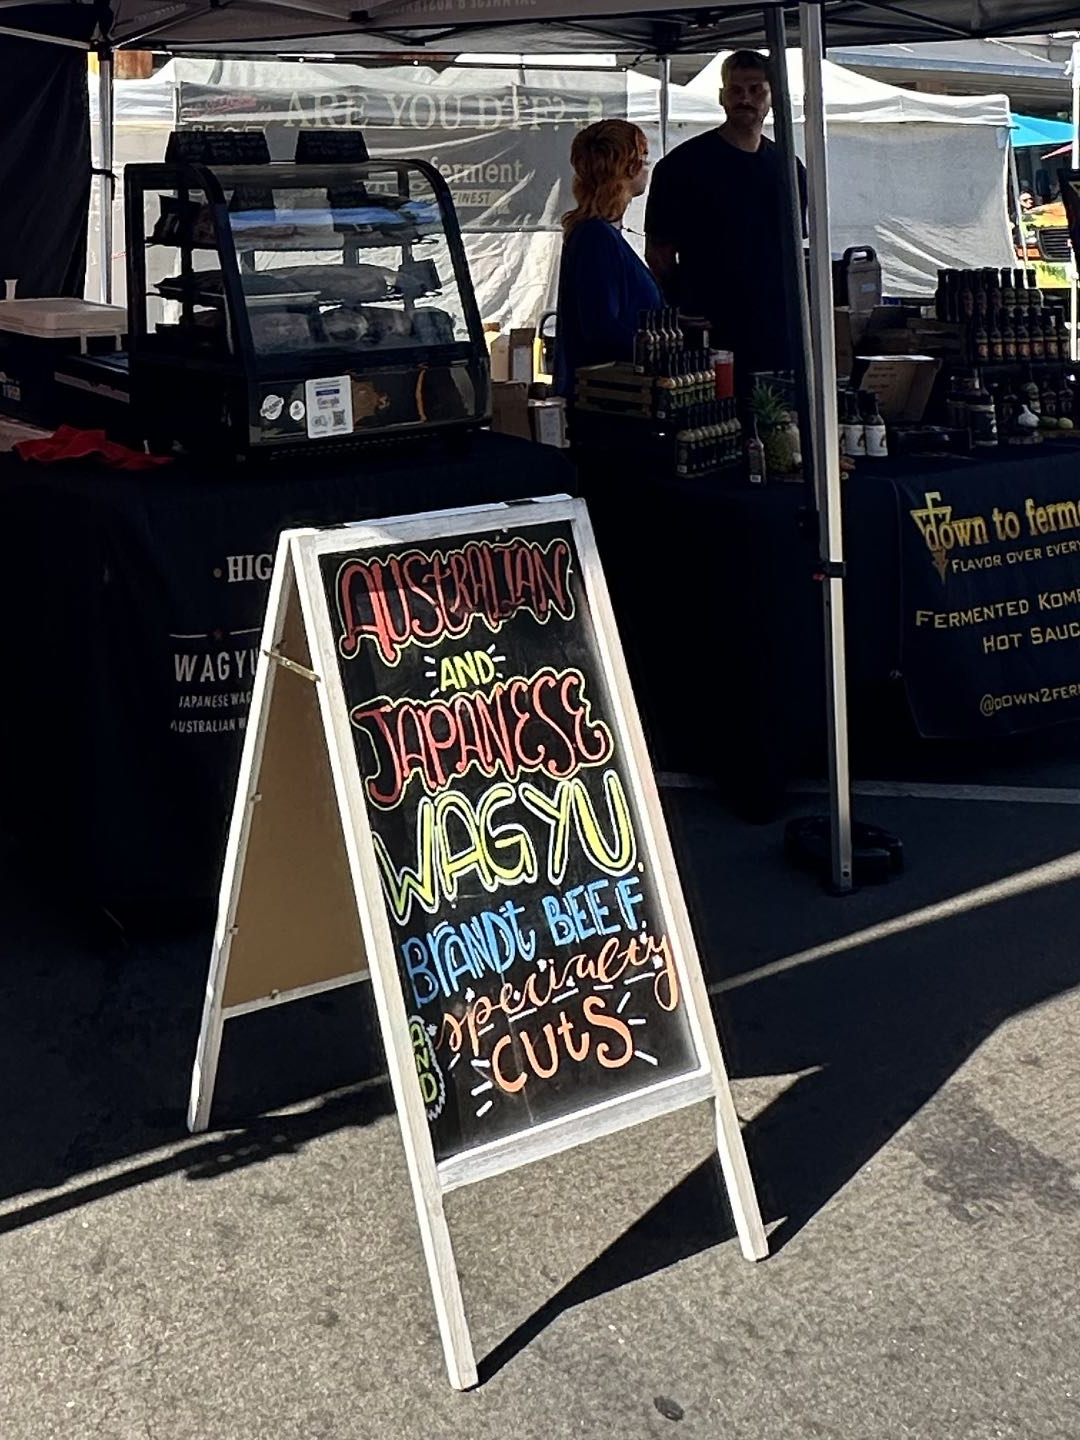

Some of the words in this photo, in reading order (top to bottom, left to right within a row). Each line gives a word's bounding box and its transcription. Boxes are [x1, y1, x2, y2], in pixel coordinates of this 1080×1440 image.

[386, 92, 462, 130] YOU
[992, 507, 1021, 541] to
[1025, 498, 1080, 537] ferm
[1006, 547, 1042, 564] OVER
[983, 633, 1022, 654] HOT
[439, 649, 496, 692] AND
[980, 683, 1080, 717] @DOWN2FER
[351, 669, 611, 807] JAPANESE
[371, 770, 636, 925] WAGYU
